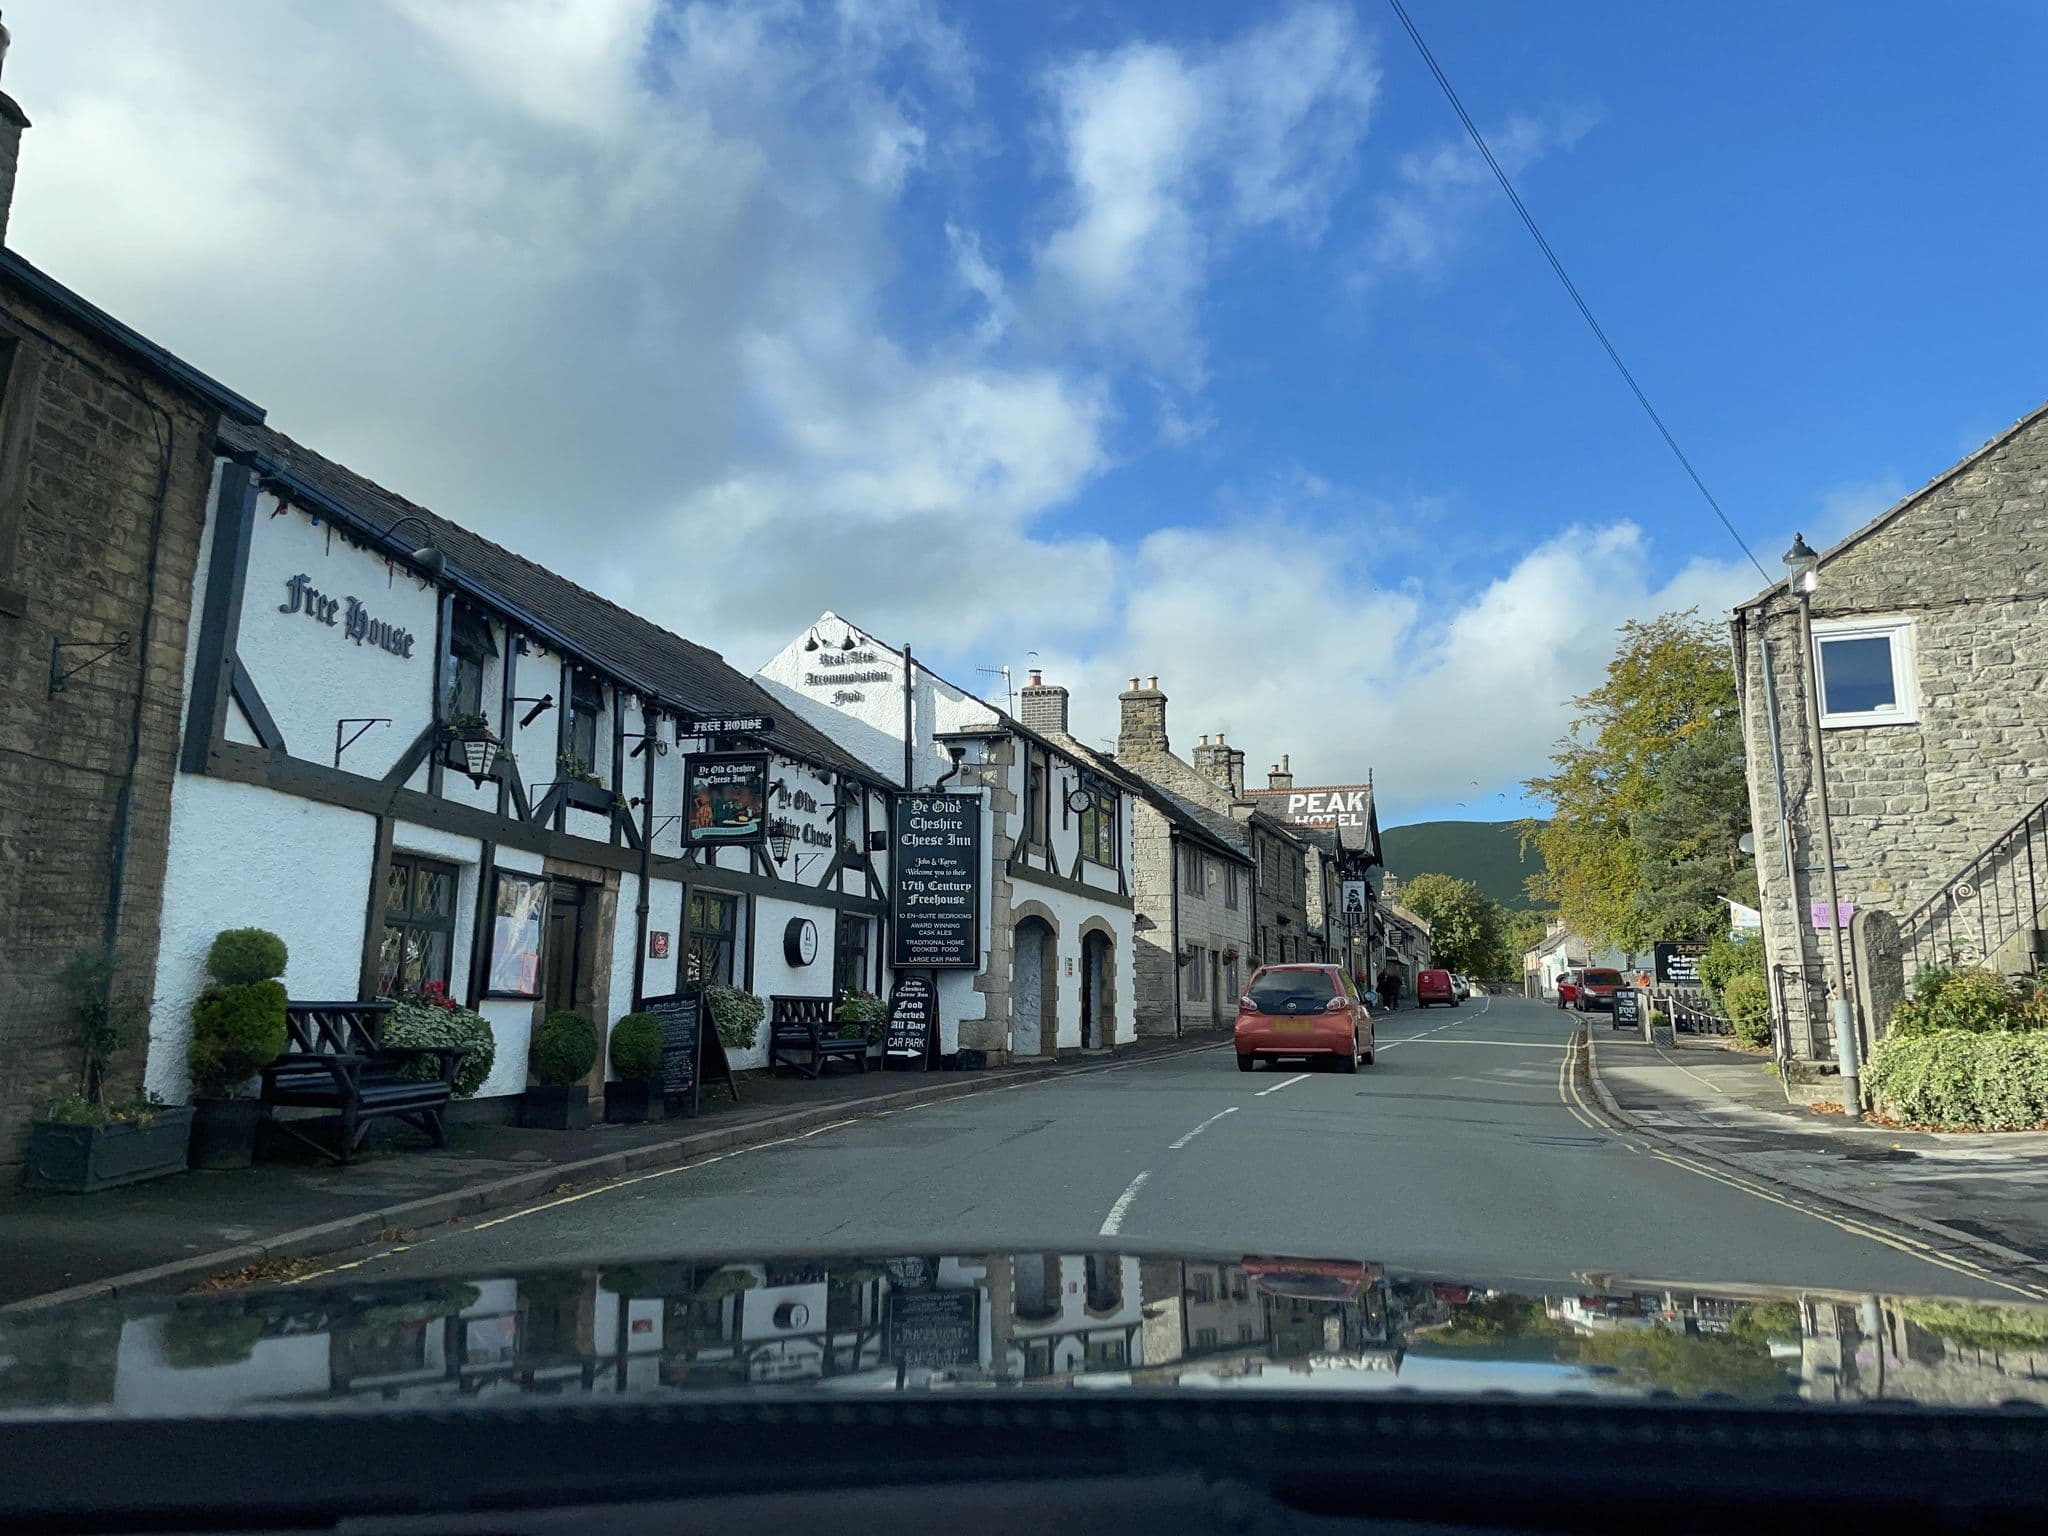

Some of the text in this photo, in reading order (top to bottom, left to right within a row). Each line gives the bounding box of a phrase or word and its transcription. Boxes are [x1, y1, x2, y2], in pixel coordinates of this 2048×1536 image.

[279, 573, 416, 660] Free House
[819, 651, 845, 666] Real
[804, 669, 889, 685] Accommodation
[830, 690, 863, 706] Food
[693, 719, 762, 732] FREE HOUSE
[699, 766, 709, 775] Ye
[726, 764, 756, 774] Cheshire
[708, 775, 731, 785] Cheese
[793, 789, 818, 814] Olde
[911, 799, 962, 814] Ye Olde
[1288, 791, 1365, 814] PEAK
[910, 817, 963, 831] Cheshire
[1294, 813, 1363, 826] HOTEL
[802, 822, 832, 849] Cheese
[901, 833, 971, 848] Cheese Inn
[915, 857, 931, 868] John
[905, 868, 933, 876] Welcome
[934, 869, 945, 878] you
[953, 868, 966, 876] their
[902, 881, 972, 893] 17th Century
[907, 893, 966, 906] Freehouse
[897, 1001, 923, 1010] Food
[893, 1010, 925, 1019] Served
[890, 1021, 926, 1031] All Day
[887, 1037, 925, 1048] CAR PARK
